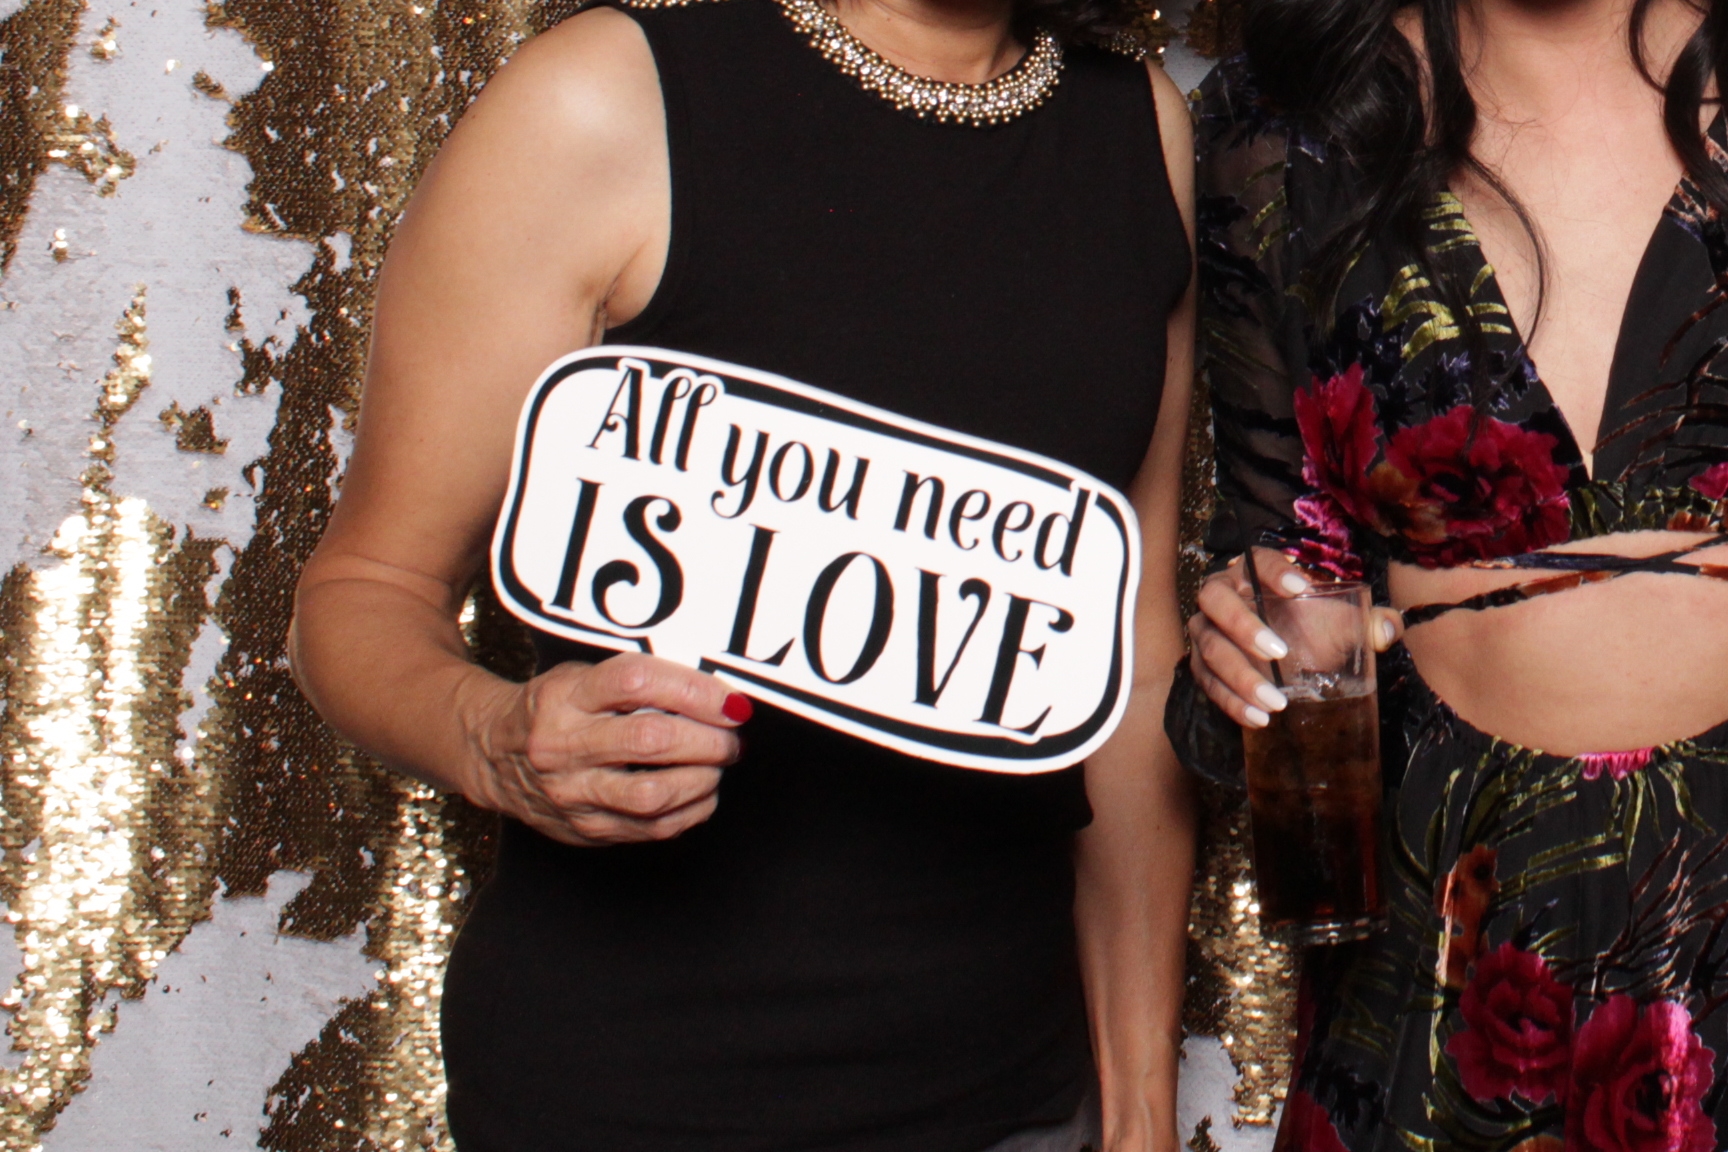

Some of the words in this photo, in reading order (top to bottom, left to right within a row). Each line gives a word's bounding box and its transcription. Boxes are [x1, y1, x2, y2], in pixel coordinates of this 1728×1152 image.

[585, 366, 718, 473] All
[710, 424, 870, 520] you
[893, 470, 1091, 576] need
[550, 478, 684, 629] IS
[721, 524, 1075, 736] LOVE
